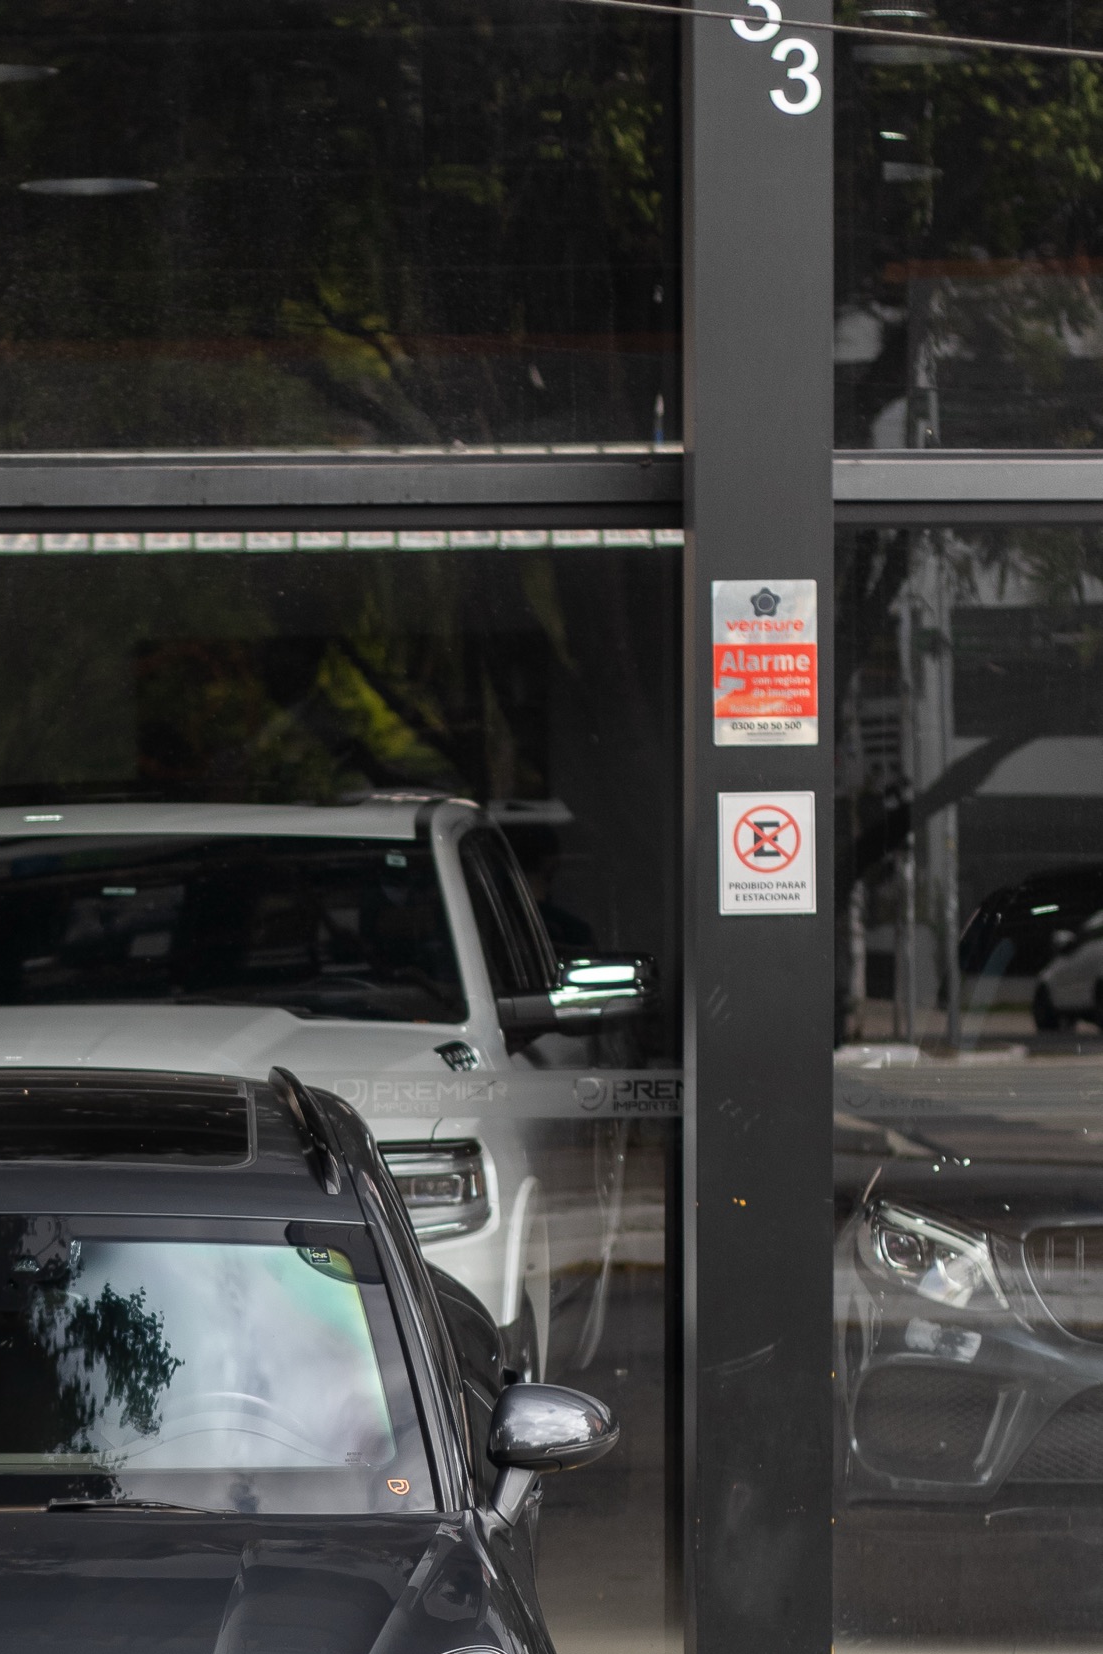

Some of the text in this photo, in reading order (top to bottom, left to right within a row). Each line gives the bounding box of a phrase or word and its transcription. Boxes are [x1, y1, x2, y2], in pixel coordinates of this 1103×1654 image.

[769, 37, 822, 115] 3
[726, 618, 805, 632] verisure
[720, 650, 811, 672] Alarme
[774, 675, 811, 686] registro
[768, 688, 811, 699] imagens
[731, 721, 802, 730] 0300 50 50 500
[728, 880, 807, 890] PROIBIDO PARAR
[735, 892, 801, 902] E ESTACIONAR
[613, 1100, 678, 1112] IMPORTS
